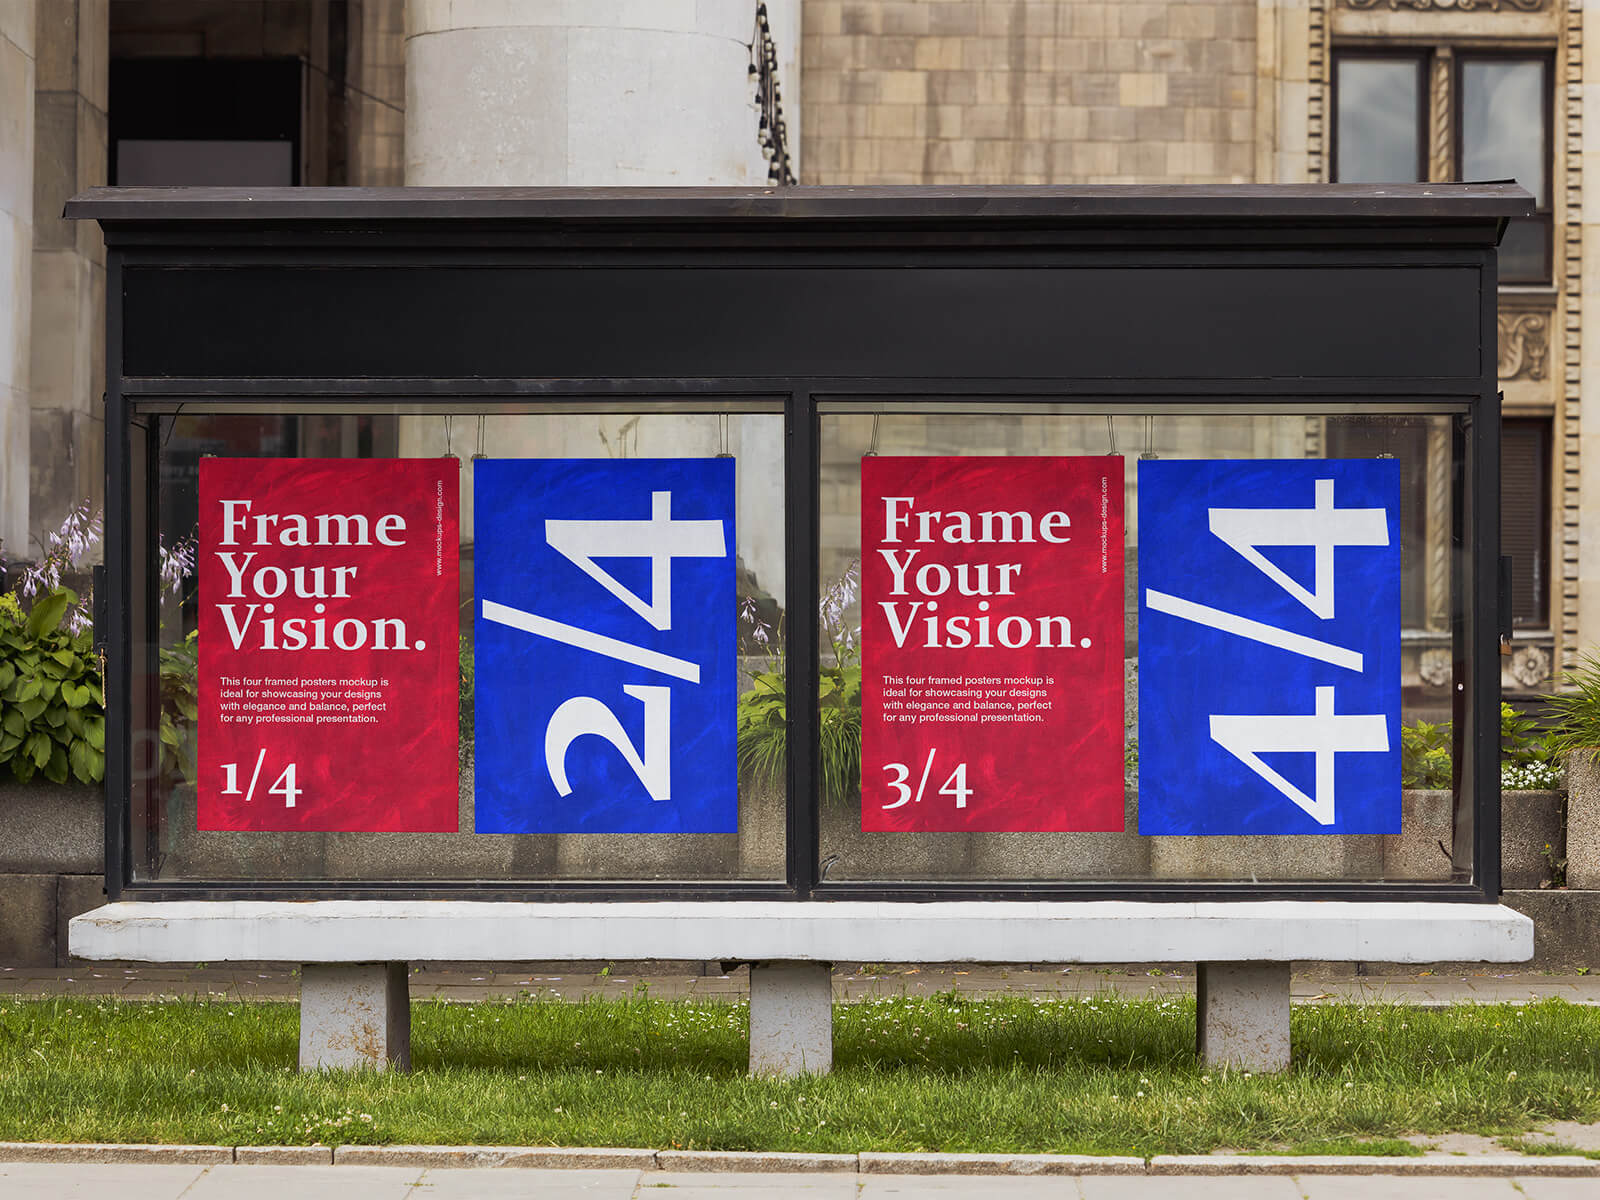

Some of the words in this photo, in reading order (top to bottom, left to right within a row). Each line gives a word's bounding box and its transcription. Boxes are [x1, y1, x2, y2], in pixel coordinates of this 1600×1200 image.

[219, 499, 407, 547] Frame
[436, 479, 445, 577] www.mockups-design.com
[881, 496, 1072, 544] Frame
[1100, 475, 1109, 574] www.mockups-design.com
[214, 551, 358, 599] Your
[876, 548, 1021, 597] Your
[215, 602, 427, 651] Vision.
[482, 490, 727, 802] 2/4
[877, 600, 1092, 649] Vision.
[1145, 478, 1390, 826] 4/4
[220, 677, 240, 686] This
[243, 677, 262, 686] four
[265, 677, 298, 686] framed
[301, 677, 336, 688] posters
[339, 677, 378, 688] mockup
[380, 677, 389, 686] is
[220, 690, 243, 698] ideal
[246, 690, 259, 698] for
[261, 689, 318, 700] showcasing
[320, 691, 341, 700] your
[344, 690, 382, 700] designs
[883, 675, 903, 684] This
[906, 675, 925, 684] four
[928, 675, 962, 684] framed
[965, 676, 1001, 686] posters
[1004, 676, 1043, 686] mockup
[1046, 676, 1054, 684] is
[883, 688, 906, 697] ideal
[909, 688, 922, 697] for
[925, 688, 982, 698] showcasing
[985, 690, 1006, 698] your
[1009, 688, 1047, 698] designs
[220, 702, 240, 710] with
[243, 702, 286, 712] elegance
[288, 702, 306, 710] and
[309, 702, 350, 712] balance,
[352, 702, 386, 712] perfect
[220, 714, 234, 722] for
[236, 716, 252, 724] any
[256, 714, 313, 724] professional
[316, 714, 378, 724] presentation.
[883, 701, 903, 709] with
[906, 701, 950, 710] elegance
[952, 701, 970, 709] and
[973, 701, 1015, 711] balance,
[1017, 701, 1052, 711] perfect
[883, 713, 897, 722] for
[899, 715, 916, 724] any
[919, 713, 978, 723] professional
[980, 713, 1044, 723] presentation.
[219, 748, 303, 808] 1/4
[881, 747, 974, 811] 3/4
